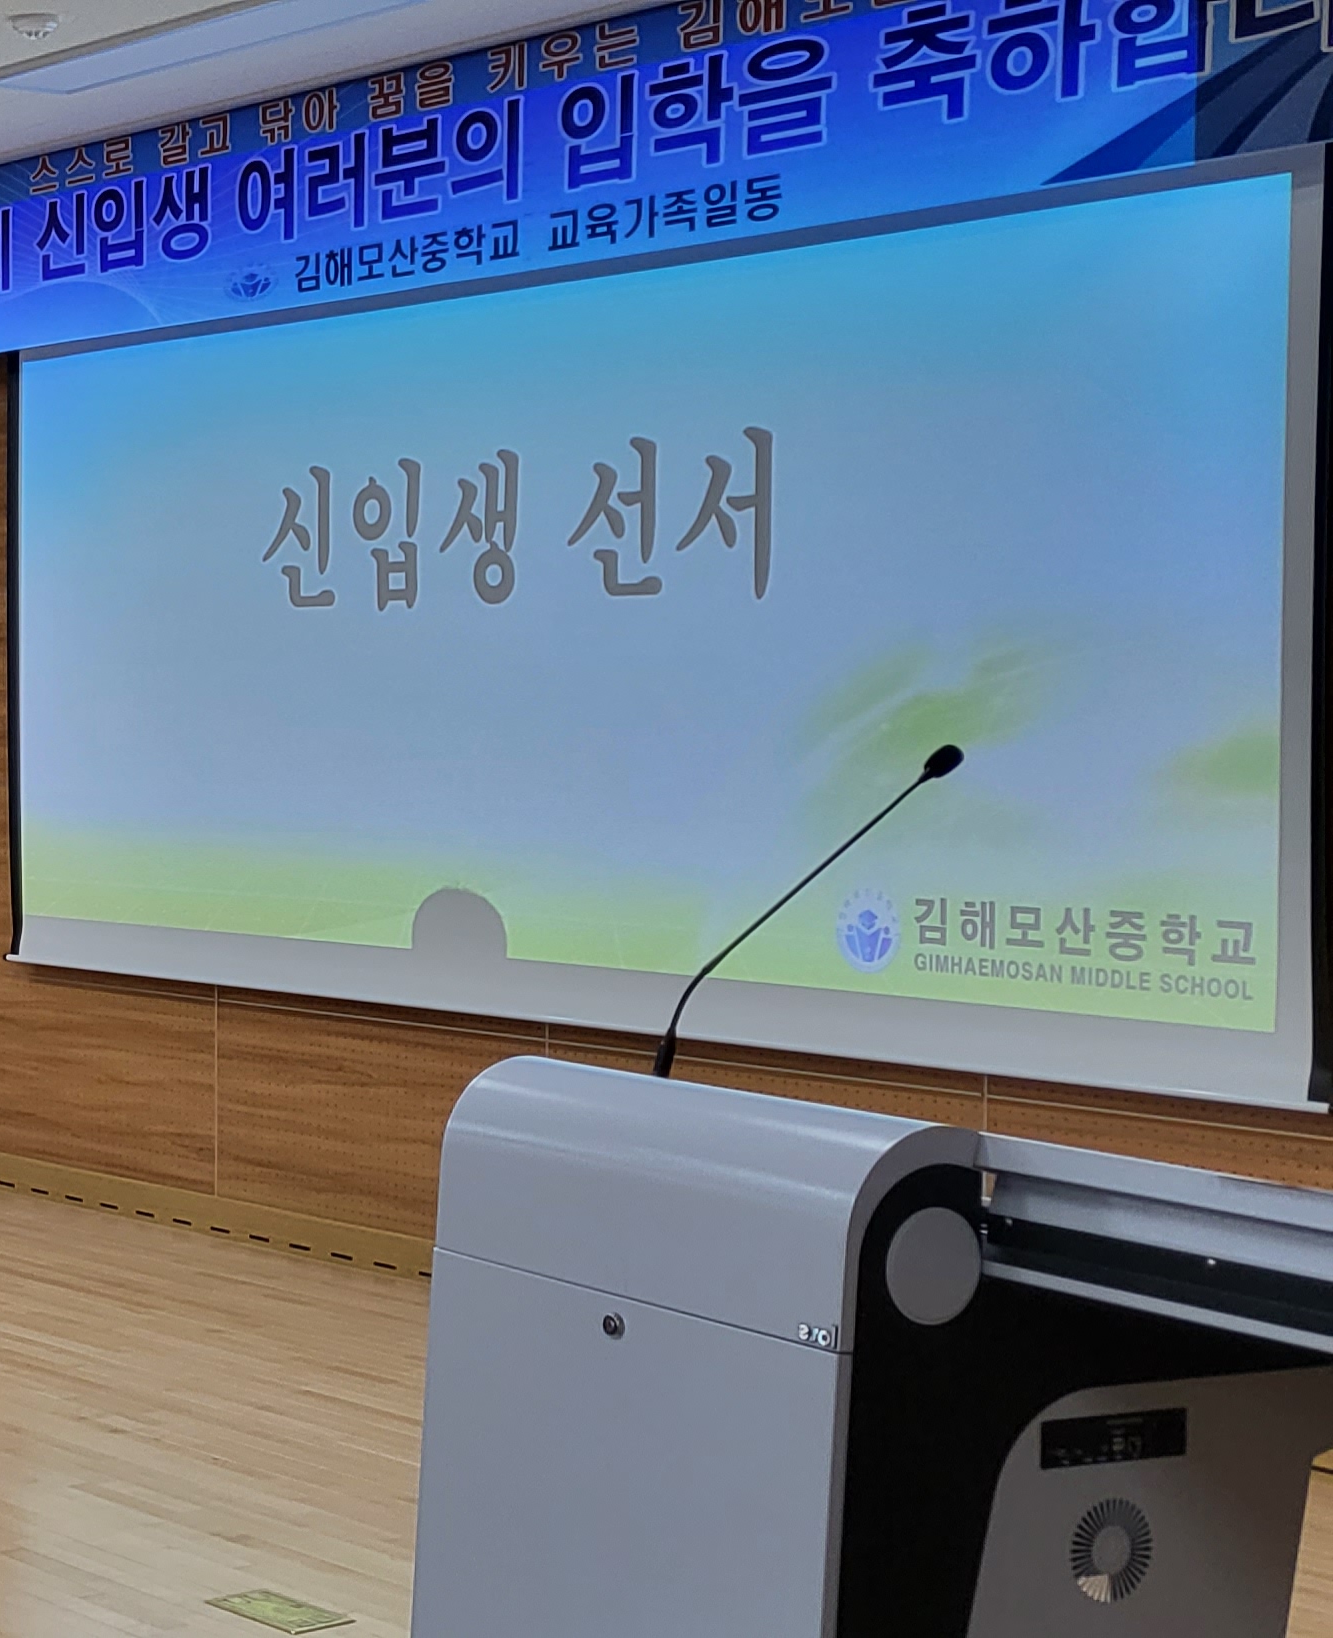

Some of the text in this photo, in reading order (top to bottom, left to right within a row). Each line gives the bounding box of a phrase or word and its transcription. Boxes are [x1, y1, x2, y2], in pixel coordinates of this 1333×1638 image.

[30, 137, 132, 194] 스스로
[159, 113, 231, 166] 갈고
[259, 90, 338, 145] 닦아
[368, 60, 455, 121] 꿈을
[488, 22, 640, 92] 키우는
[35, 163, 212, 282] 신입생
[236, 95, 524, 242] 여러분의
[558, 36, 837, 191] 입학을
[294, 219, 520, 293] 김해모산중학교
[547, 173, 783, 251] 교육가족일동
[262, 426, 774, 613] 신입생 선서
[913, 898, 1257, 967] 김해모산중학교
[913, 953, 1255, 1000] GIMHAEMOSAN MIDDLE SCHOOL
